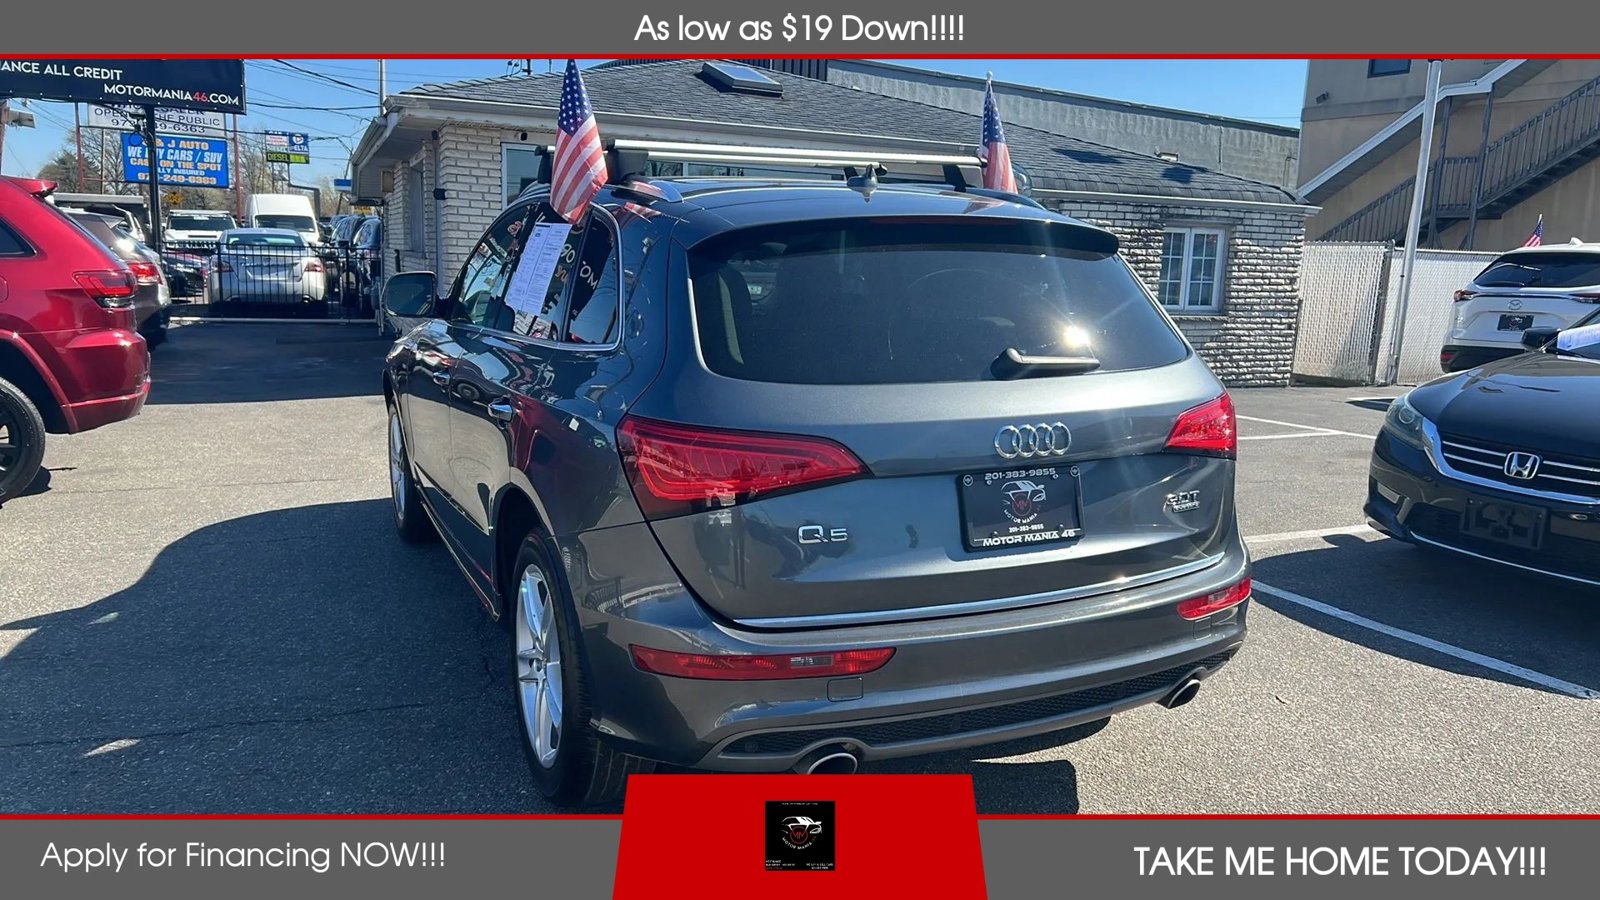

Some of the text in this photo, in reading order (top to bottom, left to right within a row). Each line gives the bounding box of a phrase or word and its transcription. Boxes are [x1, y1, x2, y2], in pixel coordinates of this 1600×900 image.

[0, 60, 123, 81] ANCE ALL CREDIT
[104, 83, 240, 106] MOTORMANIA46.COM
[178, 115, 220, 126] PUBLIC
[179, 140, 209, 150] AUTO
[127, 146, 143, 157] WE
[167, 149, 193, 162] CARS
[204, 152, 223, 163] SUV
[197, 162, 222, 171] SPOT
[985, 467, 1056, 480] 201-383-9855
[1003, 509, 1022, 524] MOTOR
[799, 525, 848, 543] Q5
[982, 529, 1076, 546] MOTOR MANIA 46
